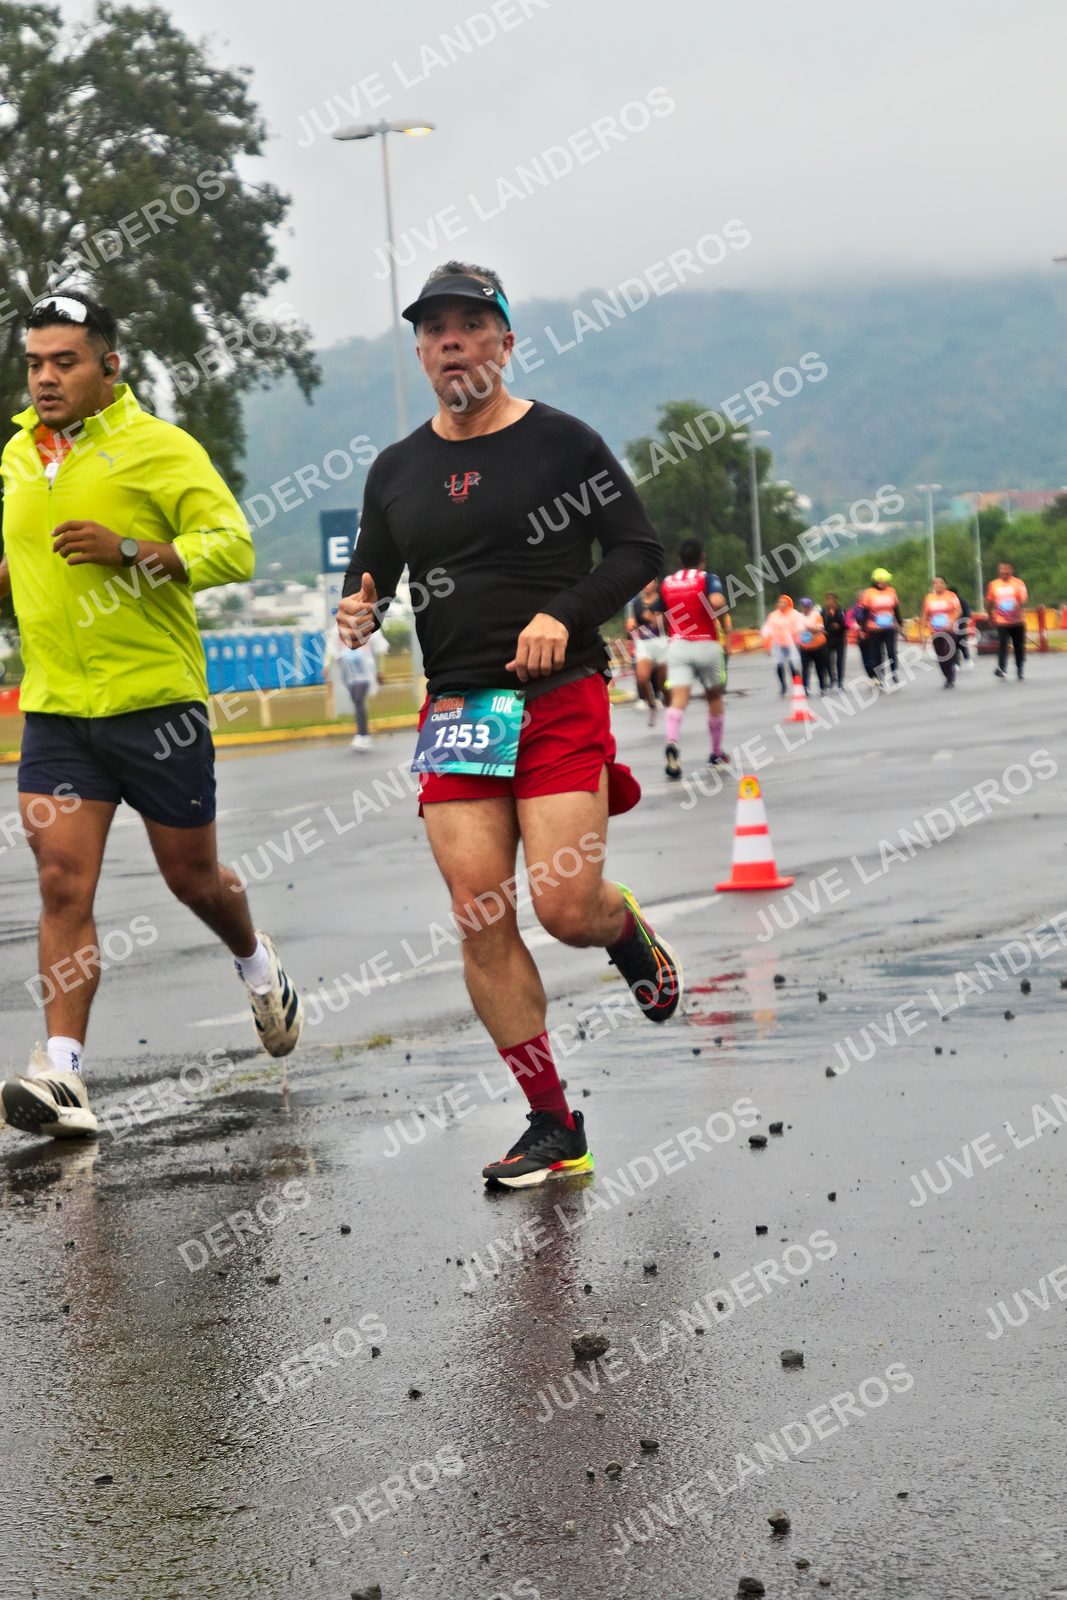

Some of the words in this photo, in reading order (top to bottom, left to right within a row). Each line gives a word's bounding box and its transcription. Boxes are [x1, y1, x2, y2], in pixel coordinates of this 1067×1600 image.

[328, 536, 350, 566] E
[491, 695, 516, 714] 10K
[434, 724, 490, 749] 1353
